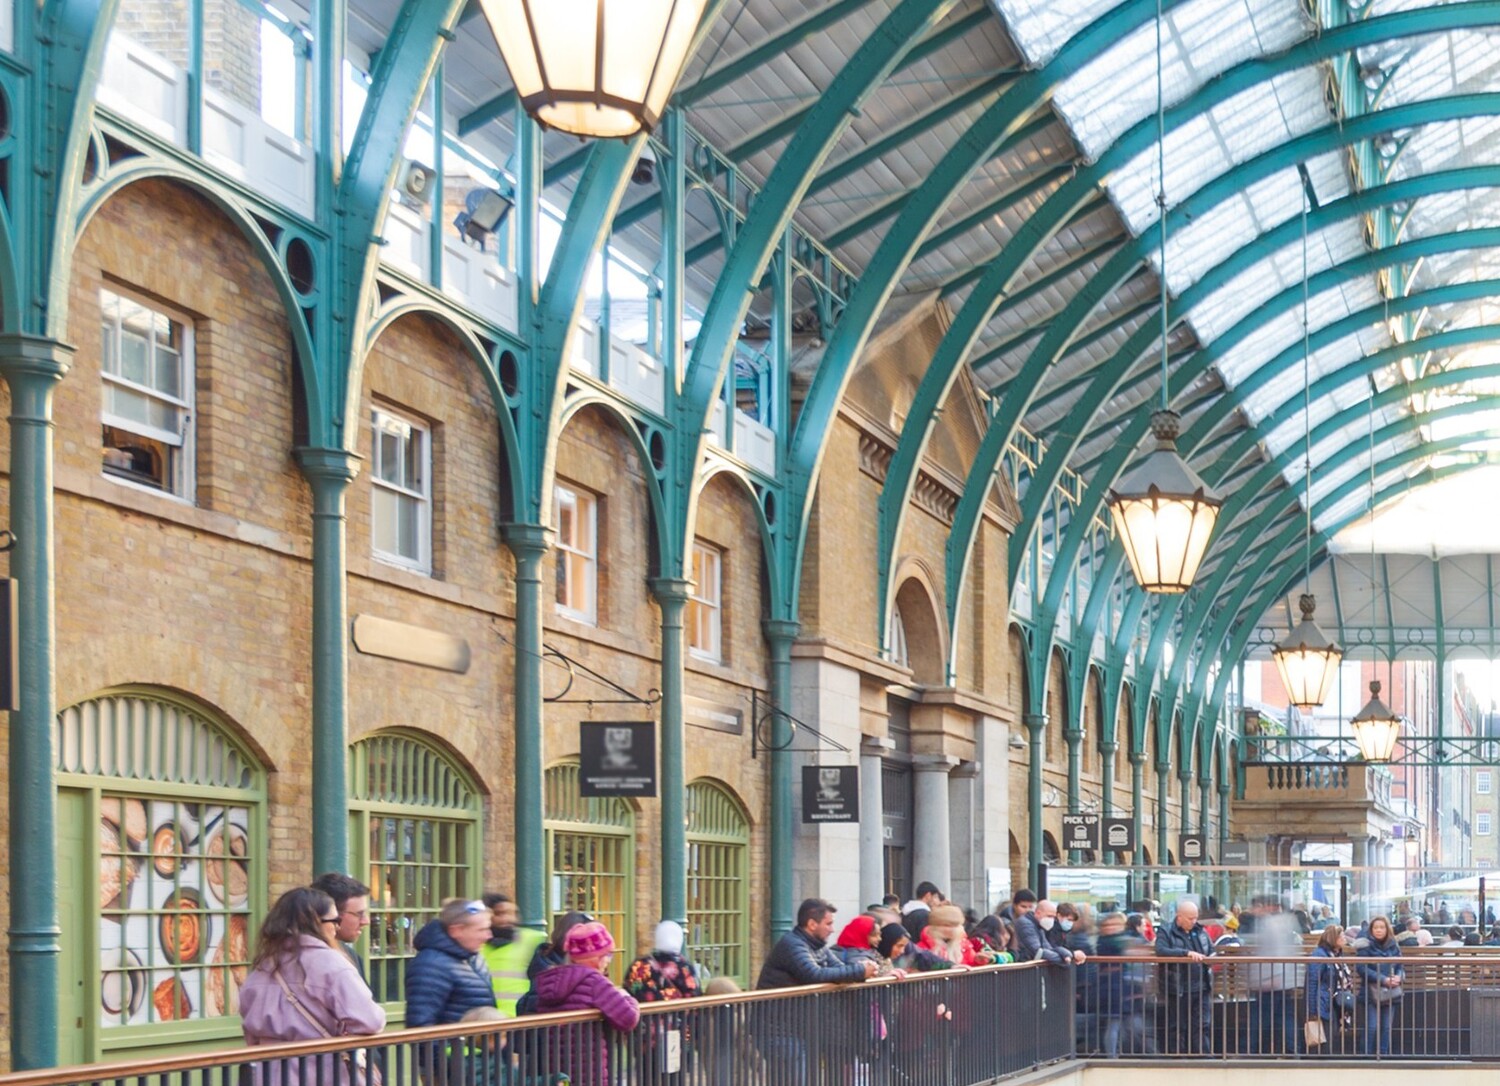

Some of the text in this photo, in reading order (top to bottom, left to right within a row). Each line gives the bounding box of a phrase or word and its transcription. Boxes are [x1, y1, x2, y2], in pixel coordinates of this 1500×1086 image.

[1064, 816, 1097, 825] PICK UP
[1070, 840, 1091, 849] HERE
